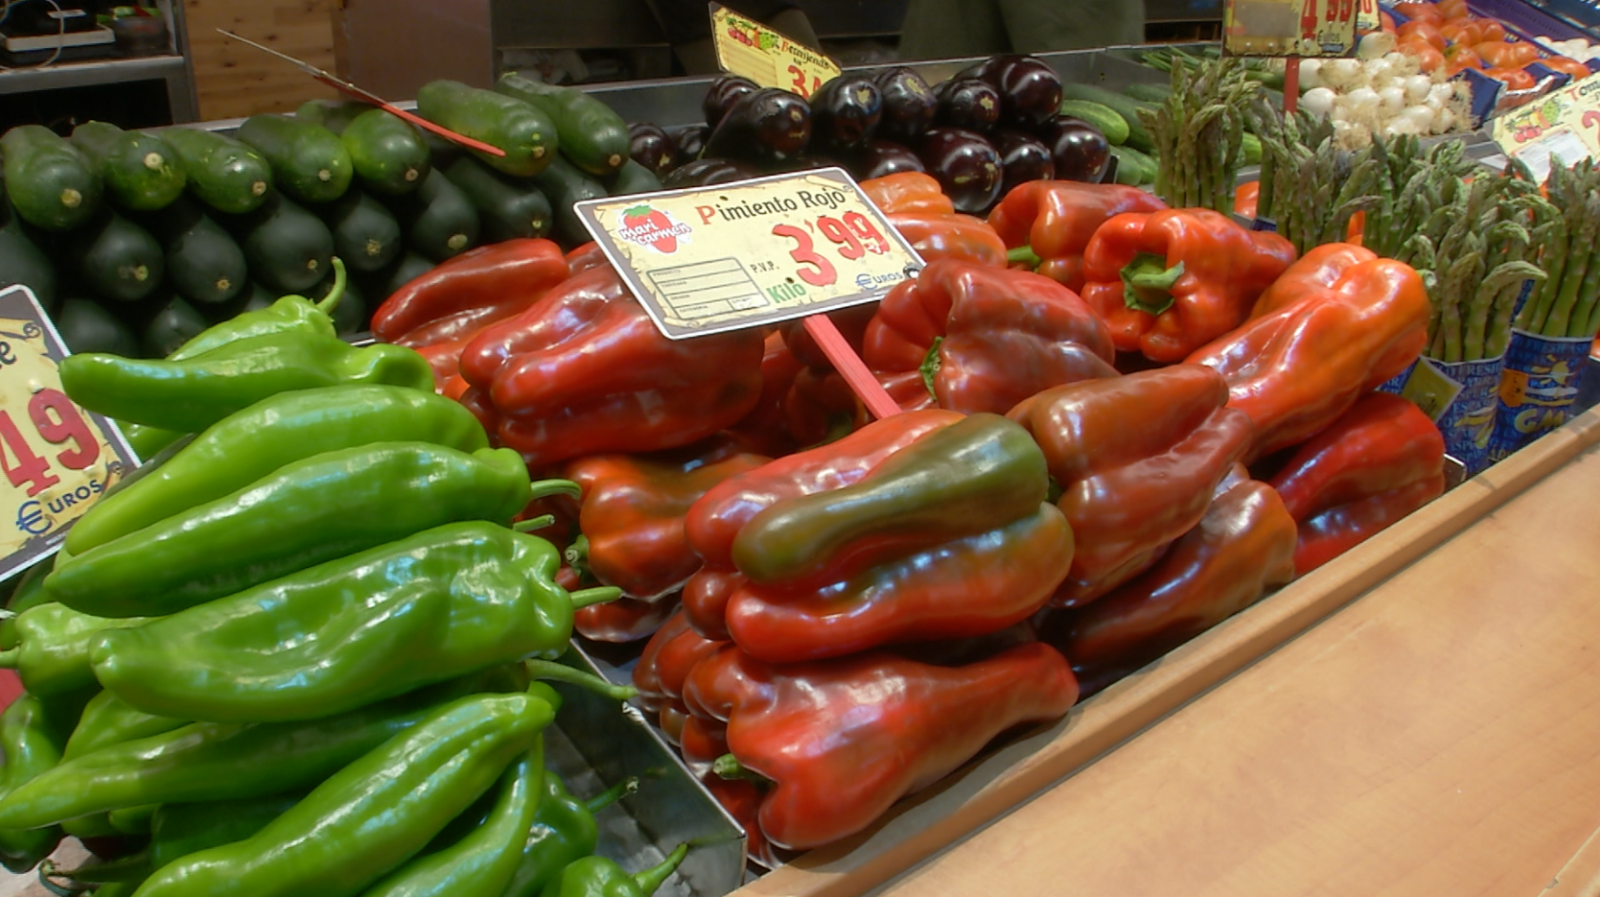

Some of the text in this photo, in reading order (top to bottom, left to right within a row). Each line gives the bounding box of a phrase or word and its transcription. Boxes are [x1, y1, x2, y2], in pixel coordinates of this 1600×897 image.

[695, 188, 846, 225] Pimiento Rojo
[750, 260, 780, 274] P.V.P.
[766, 280, 807, 304] Kilo
